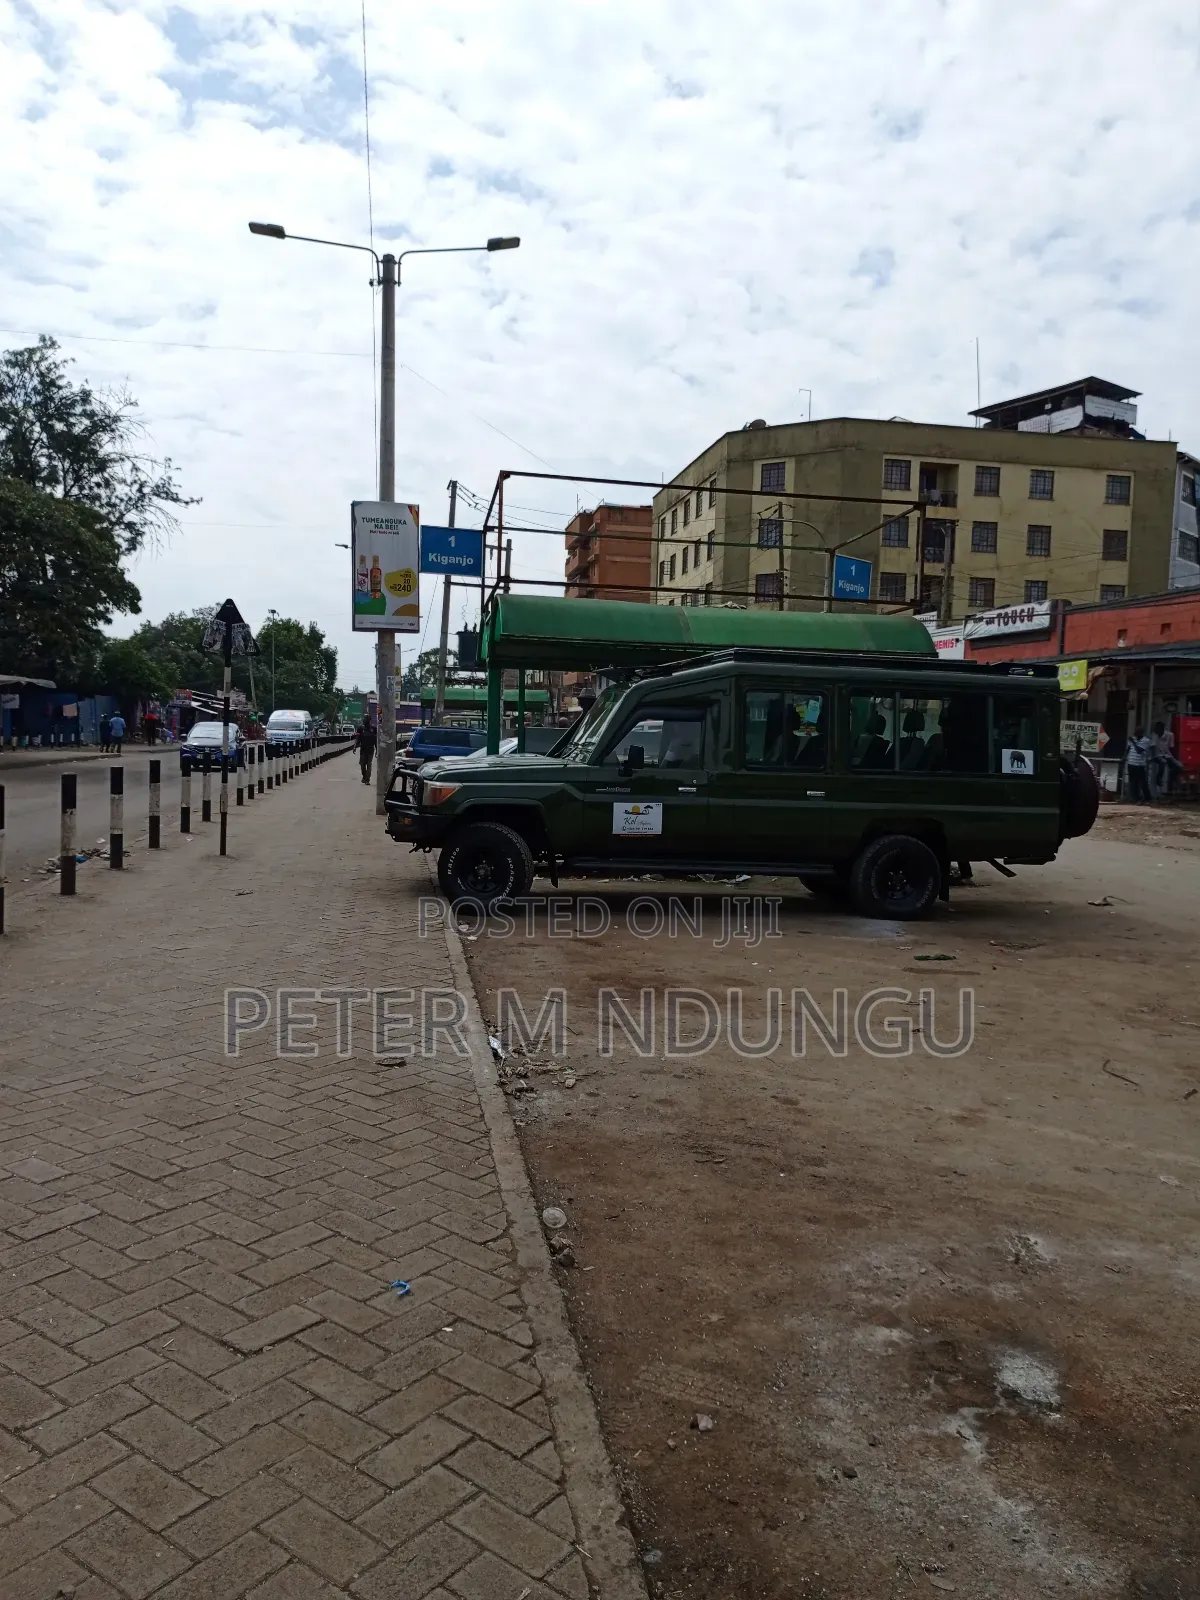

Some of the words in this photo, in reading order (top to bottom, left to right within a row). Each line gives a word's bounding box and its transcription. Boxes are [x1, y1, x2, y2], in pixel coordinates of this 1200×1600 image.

[361, 517, 408, 525] TUMEANGUKA
[448, 535, 456, 548] 1
[428, 552, 474, 567] Kiganjo
[850, 564, 856, 577] 1
[397, 583, 412, 593] 240
[838, 579, 865, 594] Kiganjo
[1077, 724, 1099, 733] CENTRE
